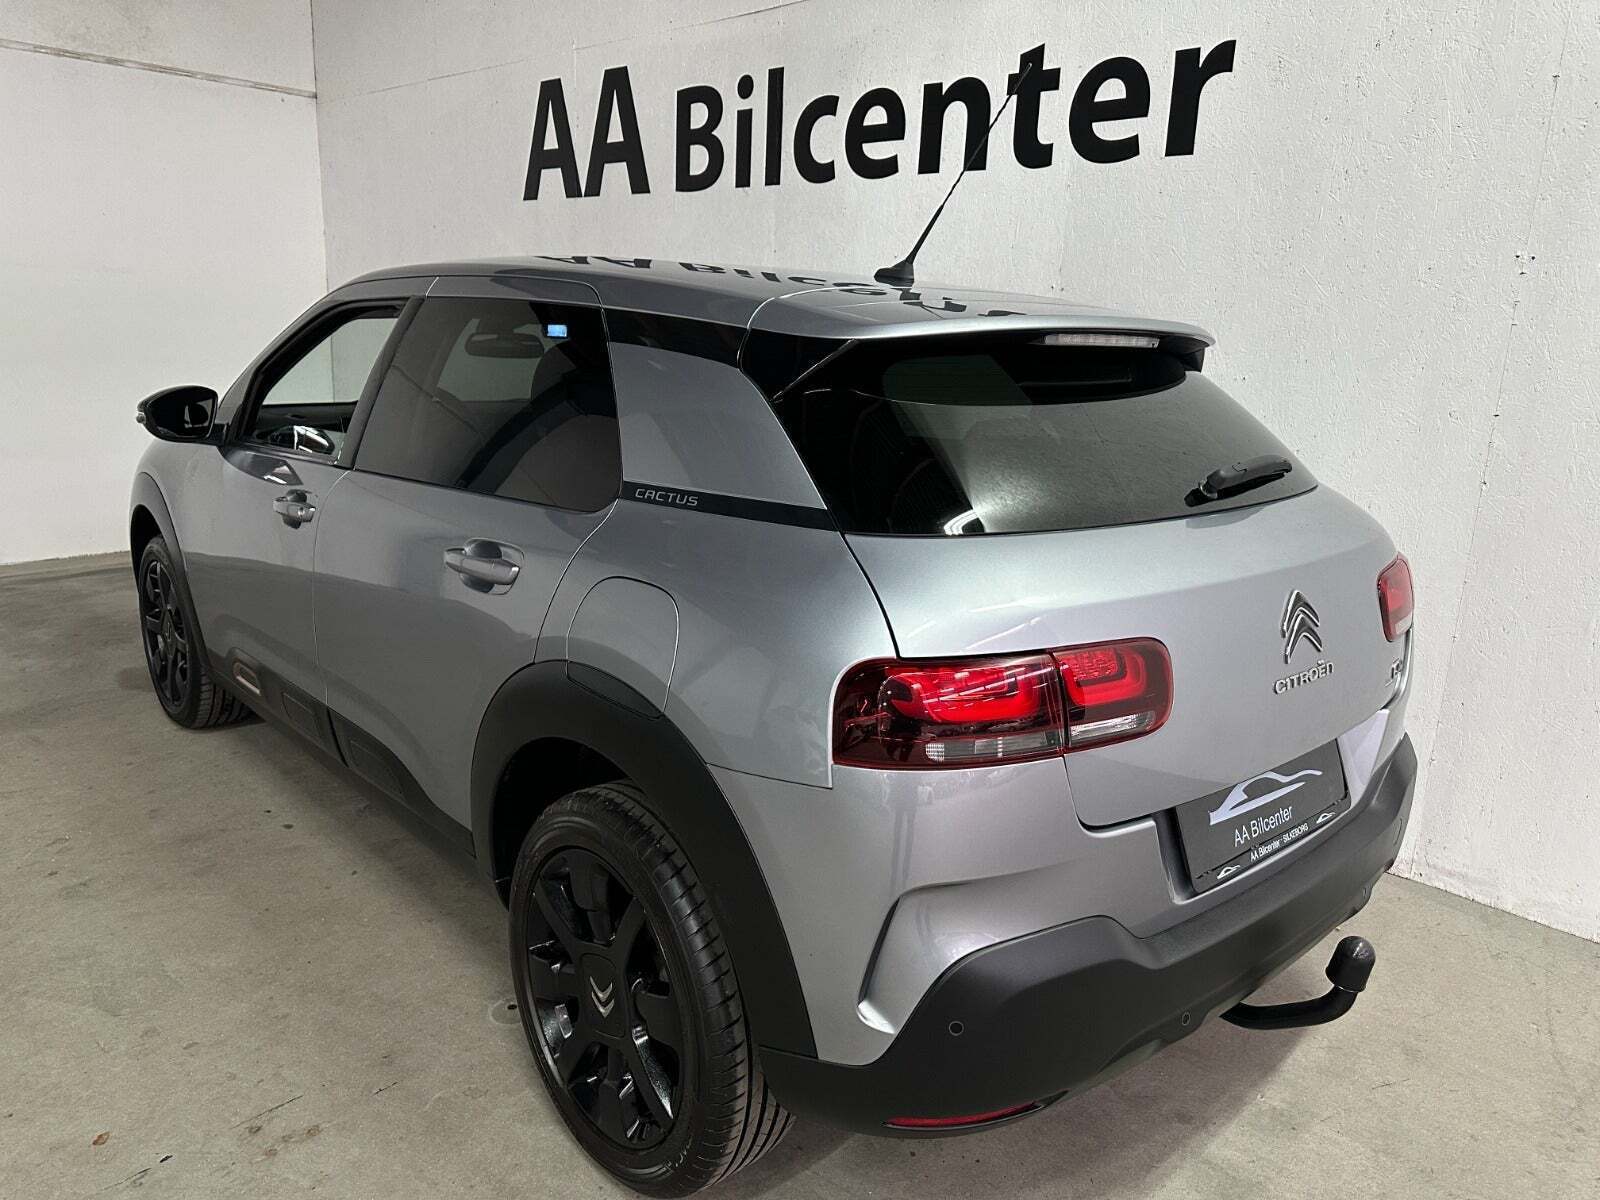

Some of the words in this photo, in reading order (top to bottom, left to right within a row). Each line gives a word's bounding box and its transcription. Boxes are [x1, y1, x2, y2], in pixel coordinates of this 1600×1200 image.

[523, 66, 650, 200] AA
[675, 40, 1236, 192] Bilcenter
[635, 488, 699, 506] CACTUS
[1234, 825, 1251, 848] AA
[1250, 806, 1293, 838] Bilcenter
